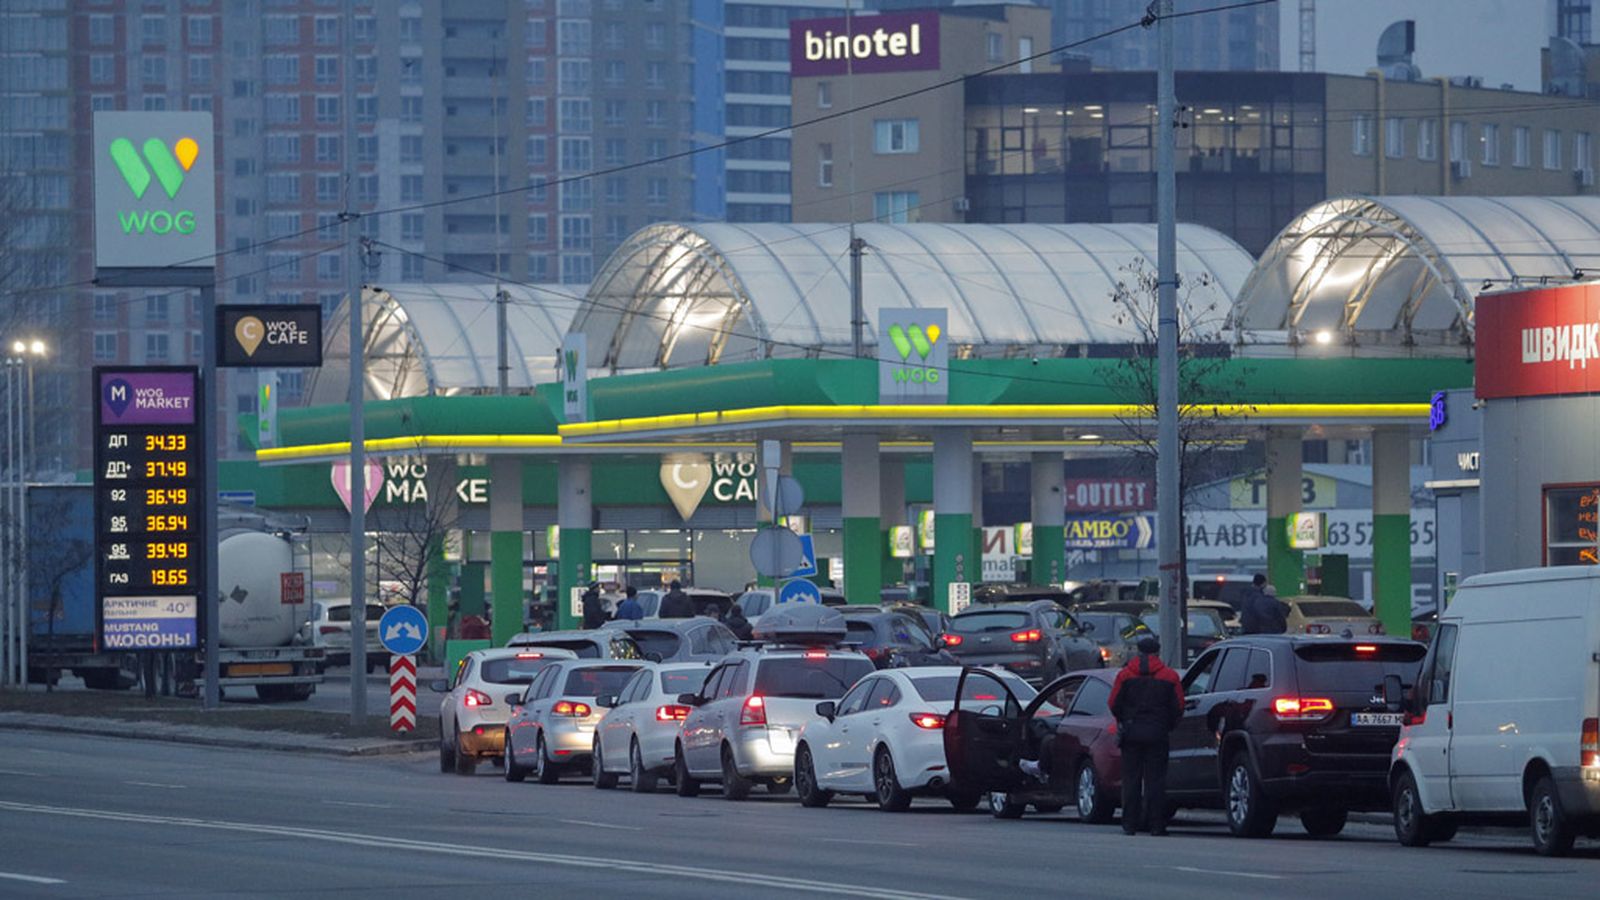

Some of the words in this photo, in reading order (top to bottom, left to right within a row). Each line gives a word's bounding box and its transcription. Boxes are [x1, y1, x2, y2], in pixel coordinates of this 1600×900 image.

[805, 23, 921, 61] binotel
[117, 210, 196, 235] WOG
[266, 321, 297, 331] WOG
[266, 331, 308, 345] CAFE
[1521, 322, 1600, 370] ШВИДК
[891, 367, 939, 385] WOG
[111, 385, 126, 401] M
[135, 388, 164, 397] WOG
[135, 397, 190, 409] MARKET
[108, 434, 128, 448] ДП
[145, 434, 187, 451] 34.33
[146, 461, 187, 478] 37.49
[387, 464, 428, 478] WO
[715, 463, 756, 477] WO
[110, 489, 126, 501] 92
[146, 488, 187, 505] 36.49
[1064, 483, 1146, 507] -OUTLET
[1250, 478, 1317, 505] ГЗ
[111, 516, 127, 528] 95
[146, 515, 187, 531] 36.94
[111, 544, 127, 556] 95
[146, 543, 187, 559] 39.49
[109, 573, 129, 584] ГАЗ
[151, 569, 188, 585] 19.65
[104, 622, 159, 633] MUSTANG
